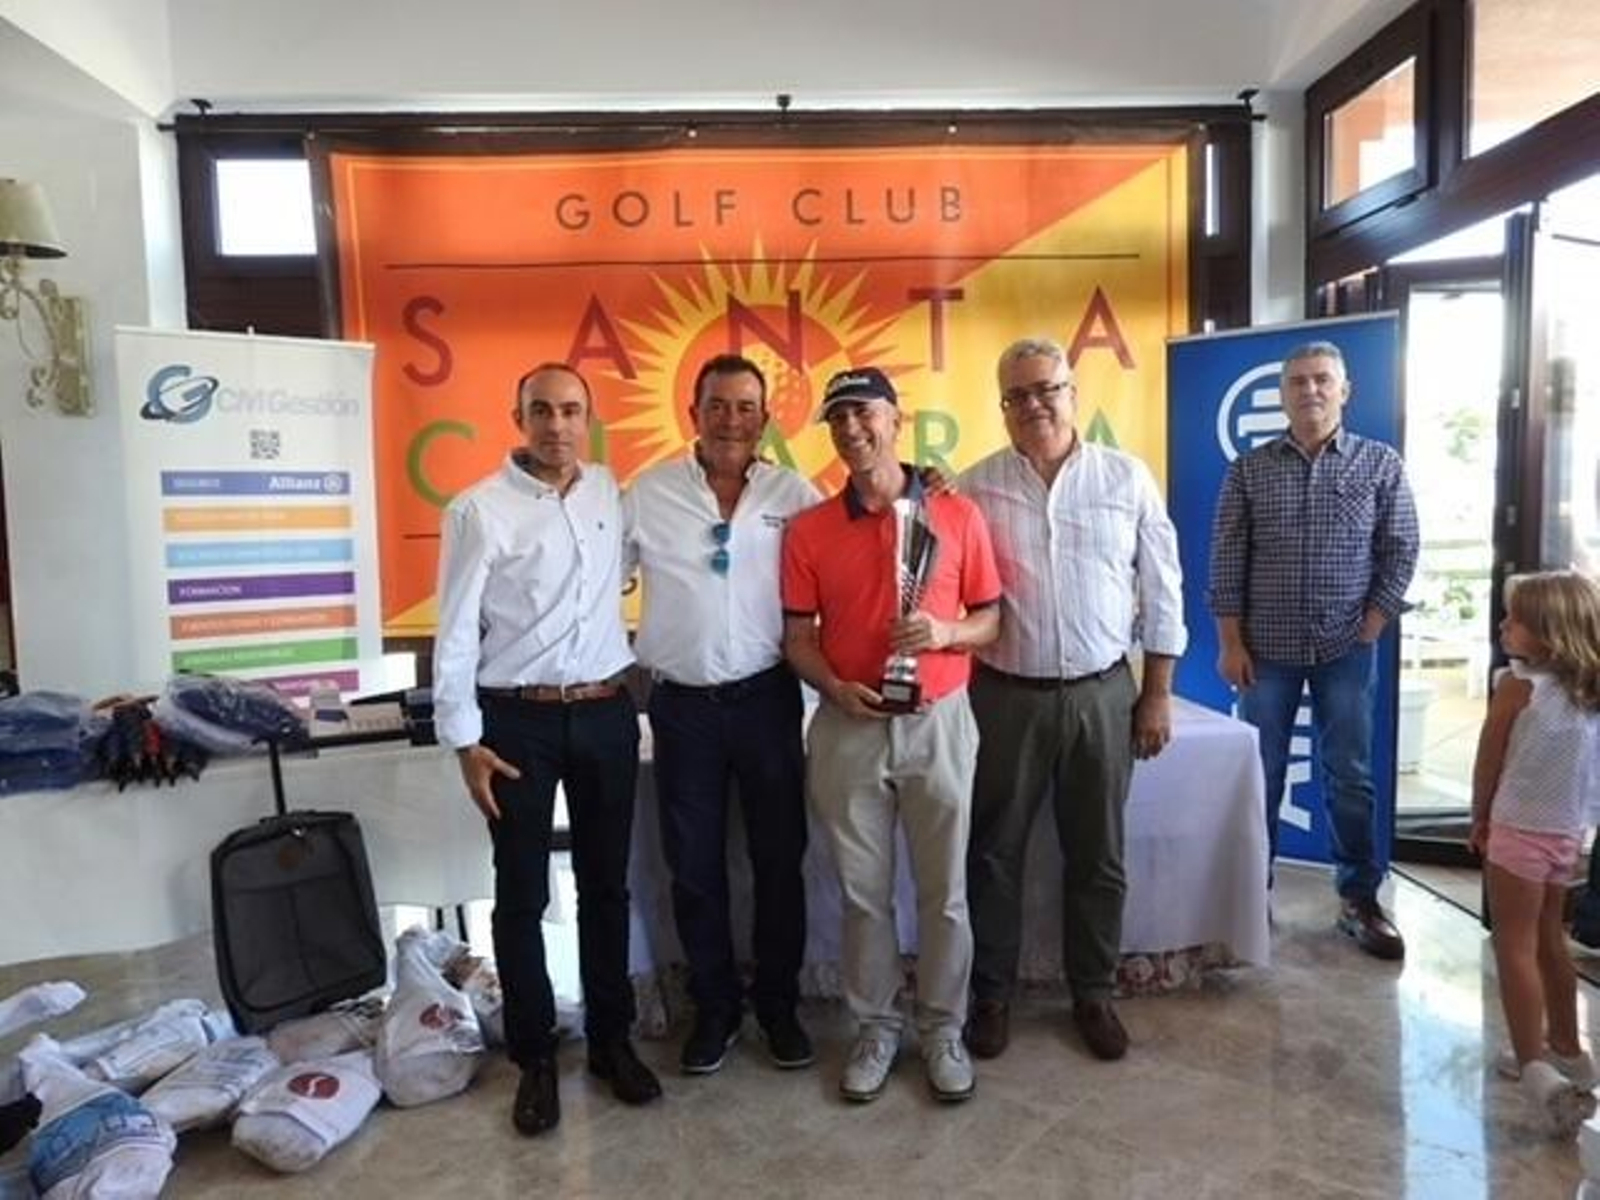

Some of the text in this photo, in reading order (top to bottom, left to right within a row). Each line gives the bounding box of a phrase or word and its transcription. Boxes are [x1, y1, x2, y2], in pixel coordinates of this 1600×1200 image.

[555, 186, 962, 230] GOLF CLUB
[402, 286, 1137, 386] SANTA
[268, 475, 322, 491] Allianz
